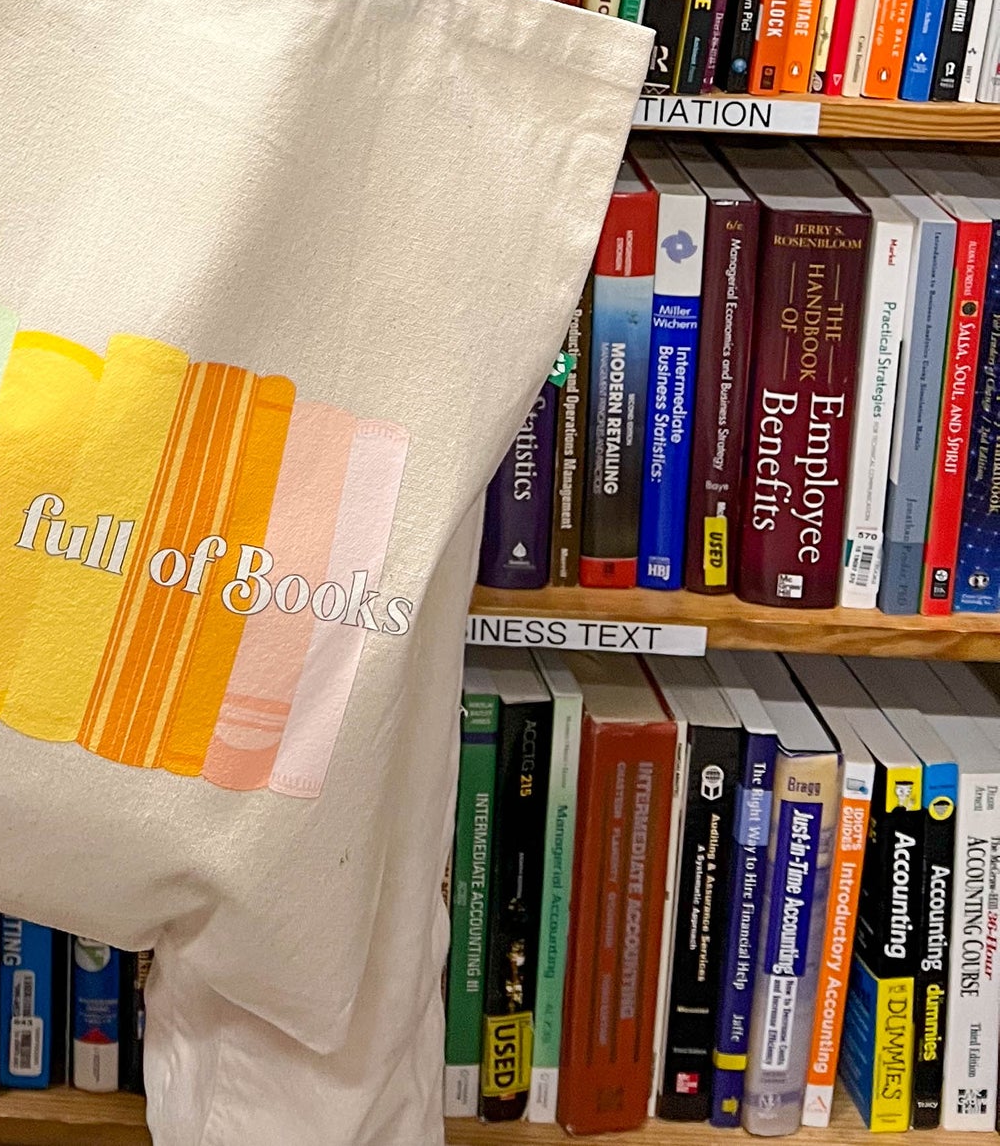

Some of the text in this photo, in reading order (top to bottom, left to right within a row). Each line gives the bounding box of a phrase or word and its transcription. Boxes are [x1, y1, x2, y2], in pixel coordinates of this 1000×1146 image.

[773, 235, 862, 249] ROSENBLOOM
[795, 224, 845, 236] JERRY S.
[653, 317, 698, 329] Wichern
[660, 305, 691, 316] Miller
[799, 264, 825, 381] HANDBOOK
[752, 388, 798, 531] Benefits
[791, 392, 845, 564] Employee
[13, 492, 136, 576] full
[148, 535, 228, 596] of
[220, 543, 414, 636] Books
[709, 531, 723, 568] USED
[857, 532, 877, 540] 570
[578, 623, 662, 650] TEXT
[520, 775, 532, 797] 215
[787, 776, 821, 796] Bragg
[467, 793, 489, 979] INTERMEDIATE ACCOUNTING
[884, 830, 916, 959] Accounting
[960, 939, 984, 998] COURSE
[494, 1023, 515, 1088] USED
[881, 998, 907, 1100] DUMMIES
[968, 1022, 982, 1078] Third Edition
